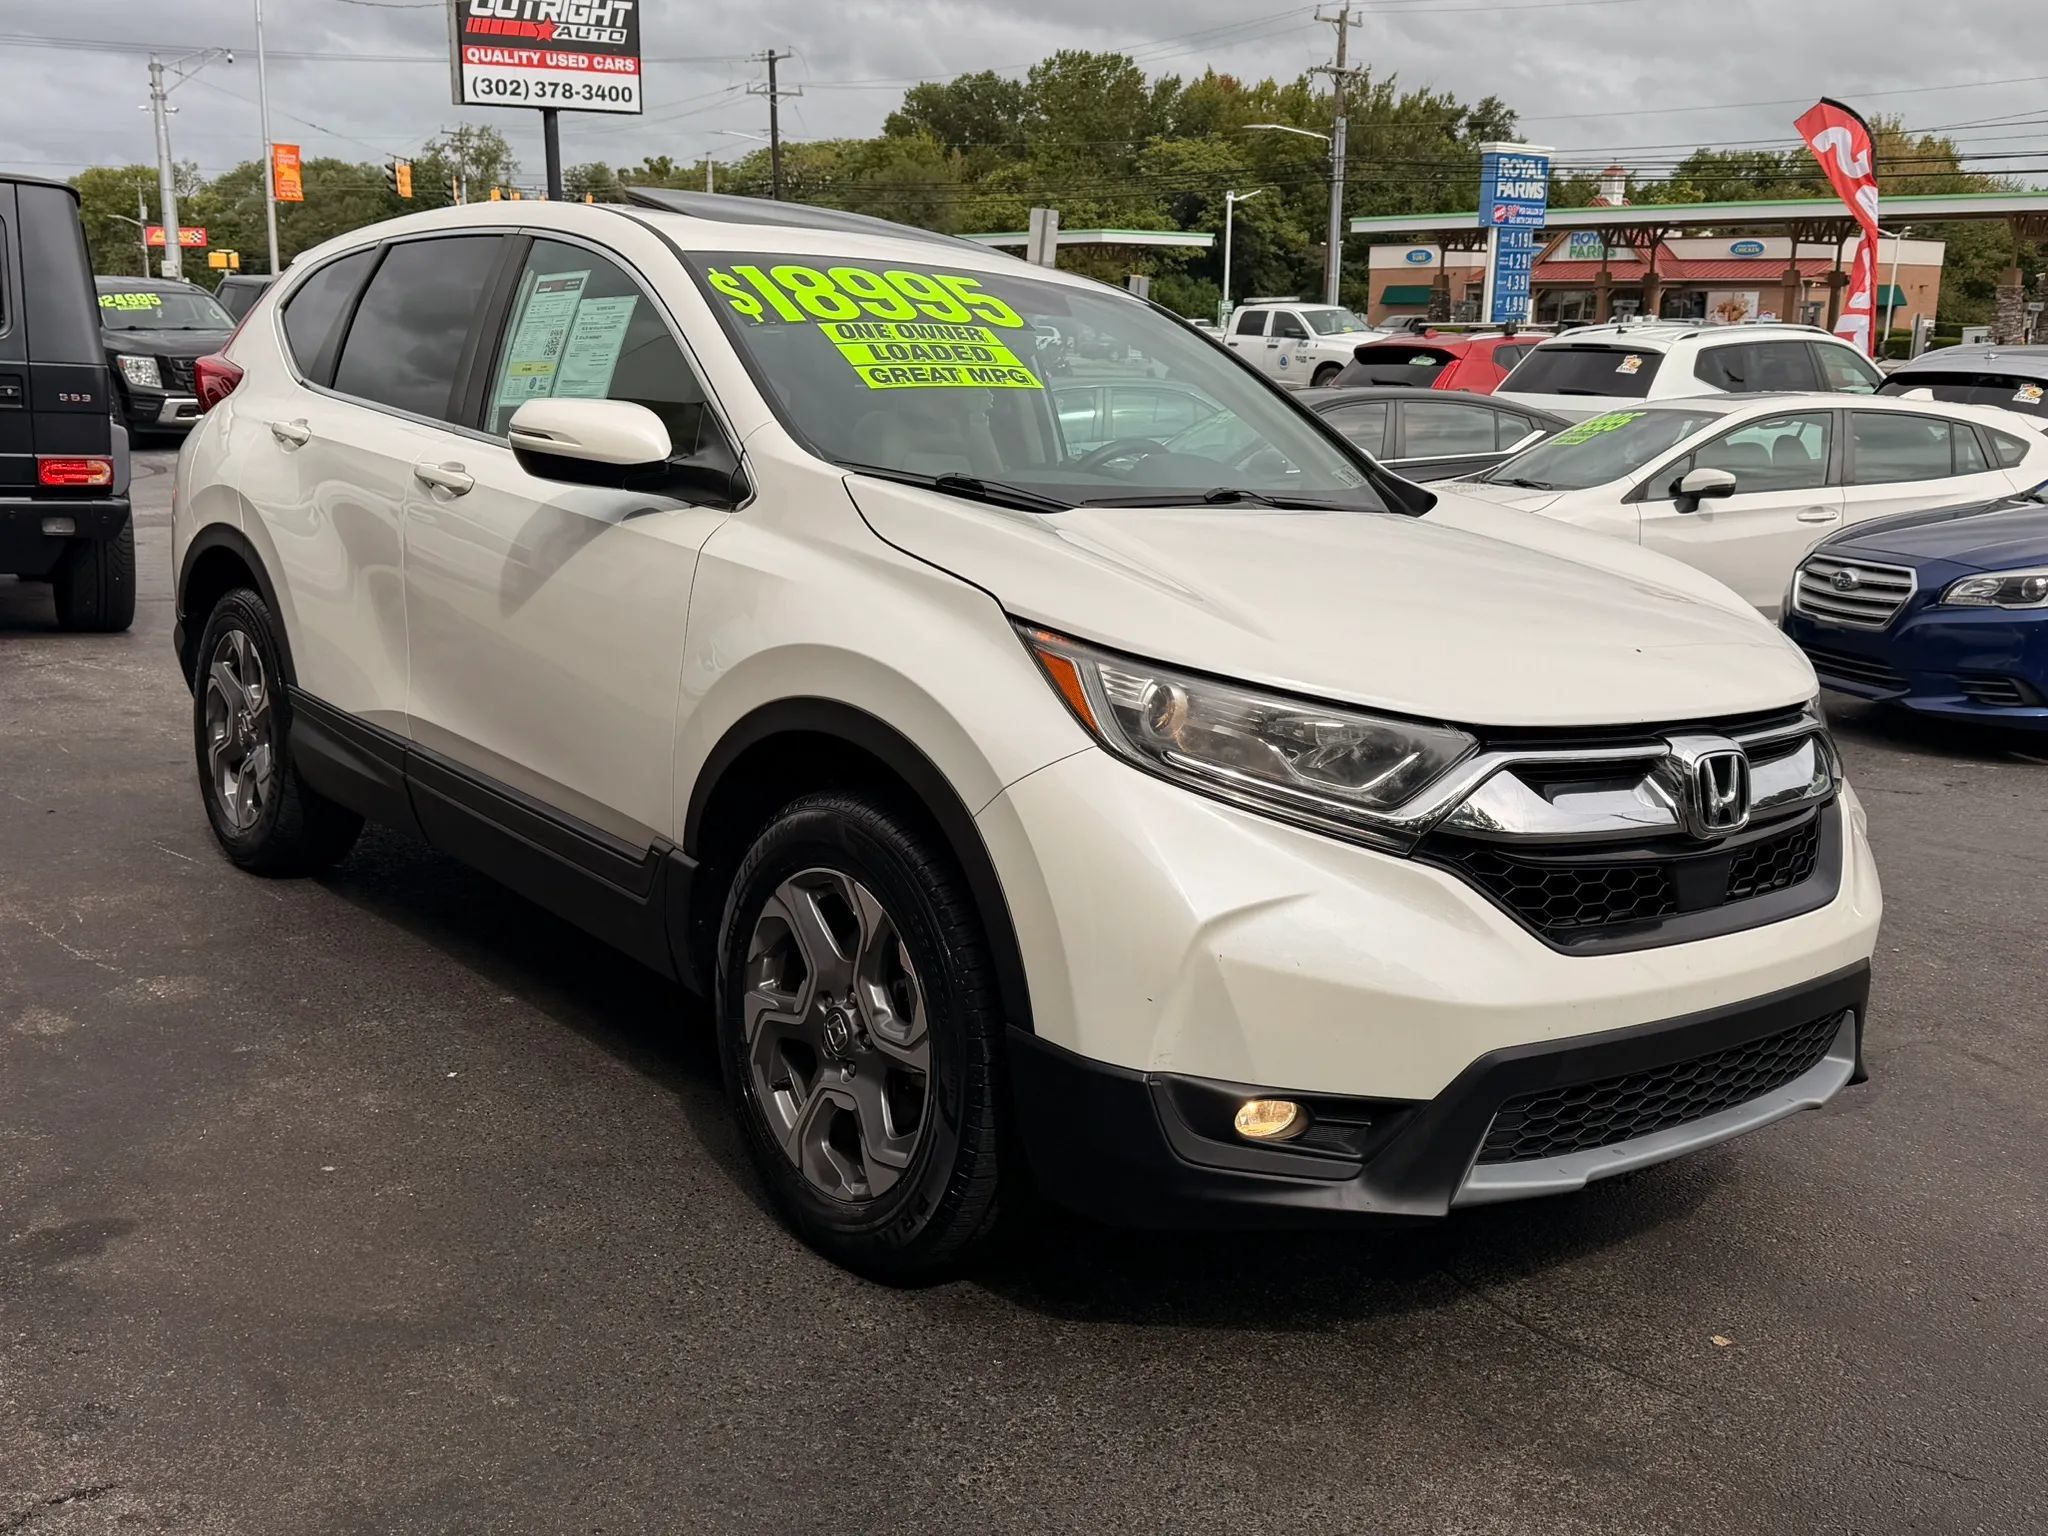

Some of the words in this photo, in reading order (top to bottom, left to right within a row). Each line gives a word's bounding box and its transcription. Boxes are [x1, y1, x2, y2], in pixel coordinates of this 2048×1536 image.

[557, 26, 625, 42] AUTO
[466, 48, 541, 65] QUALITY
[546, 53, 589, 68] USED
[593, 58, 635, 72] CARS
[472, 76, 530, 100] (302)
[534, 81, 633, 102] 378-3400
[1497, 157, 1546, 178] ROYAL
[1496, 178, 1545, 199] FARMS
[707, 265, 1024, 327] $18995
[835, 323, 892, 340] ONE
[895, 324, 987, 342] OWNER
[867, 344, 994, 363] LOADED
[868, 367, 961, 385] GREAT
[966, 368, 1031, 386] MPG
